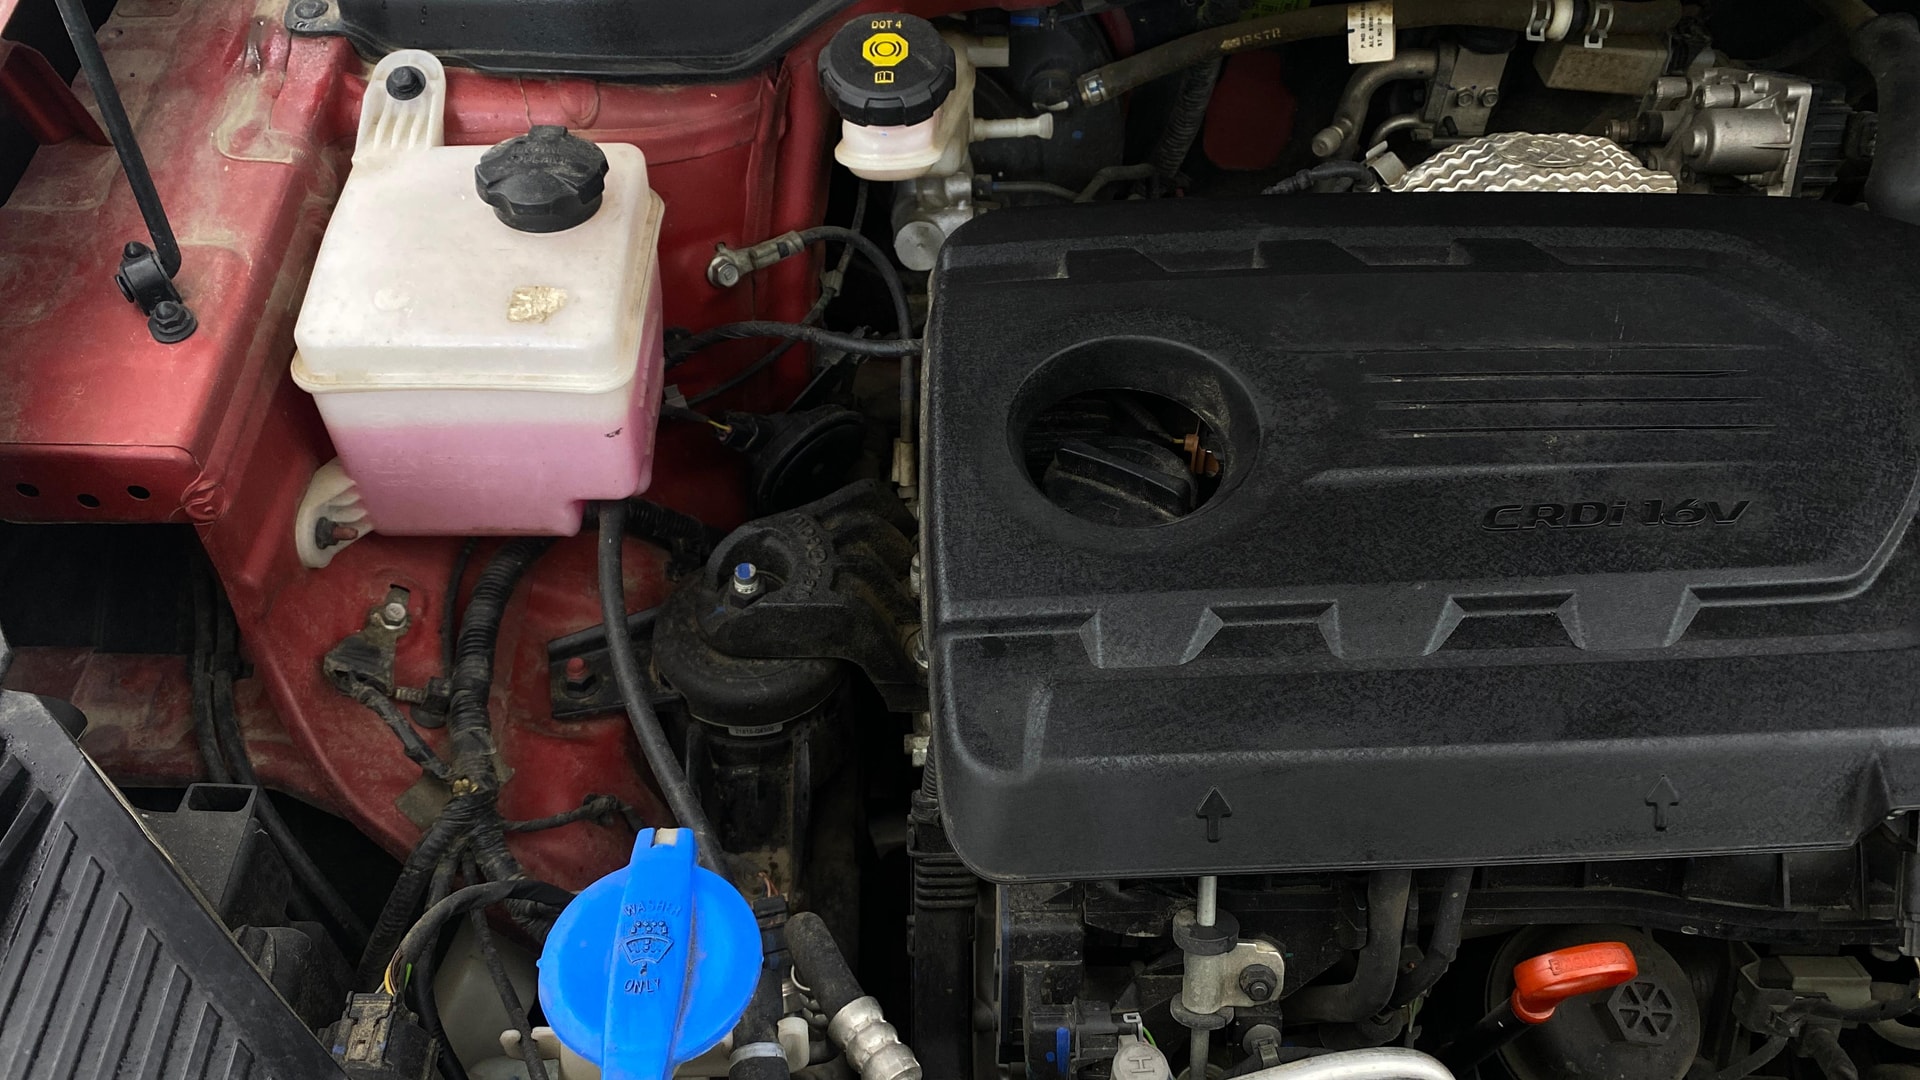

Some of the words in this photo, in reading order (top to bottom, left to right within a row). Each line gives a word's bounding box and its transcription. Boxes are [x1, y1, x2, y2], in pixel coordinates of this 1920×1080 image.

[871, 19, 893, 29] DOT
[895, 19, 903, 29] 4
[1481, 499, 1628, 531] CRDi
[1643, 497, 1752, 527] 16V
[624, 899, 683, 918] WASHER
[624, 976, 661, 995] ONLY
